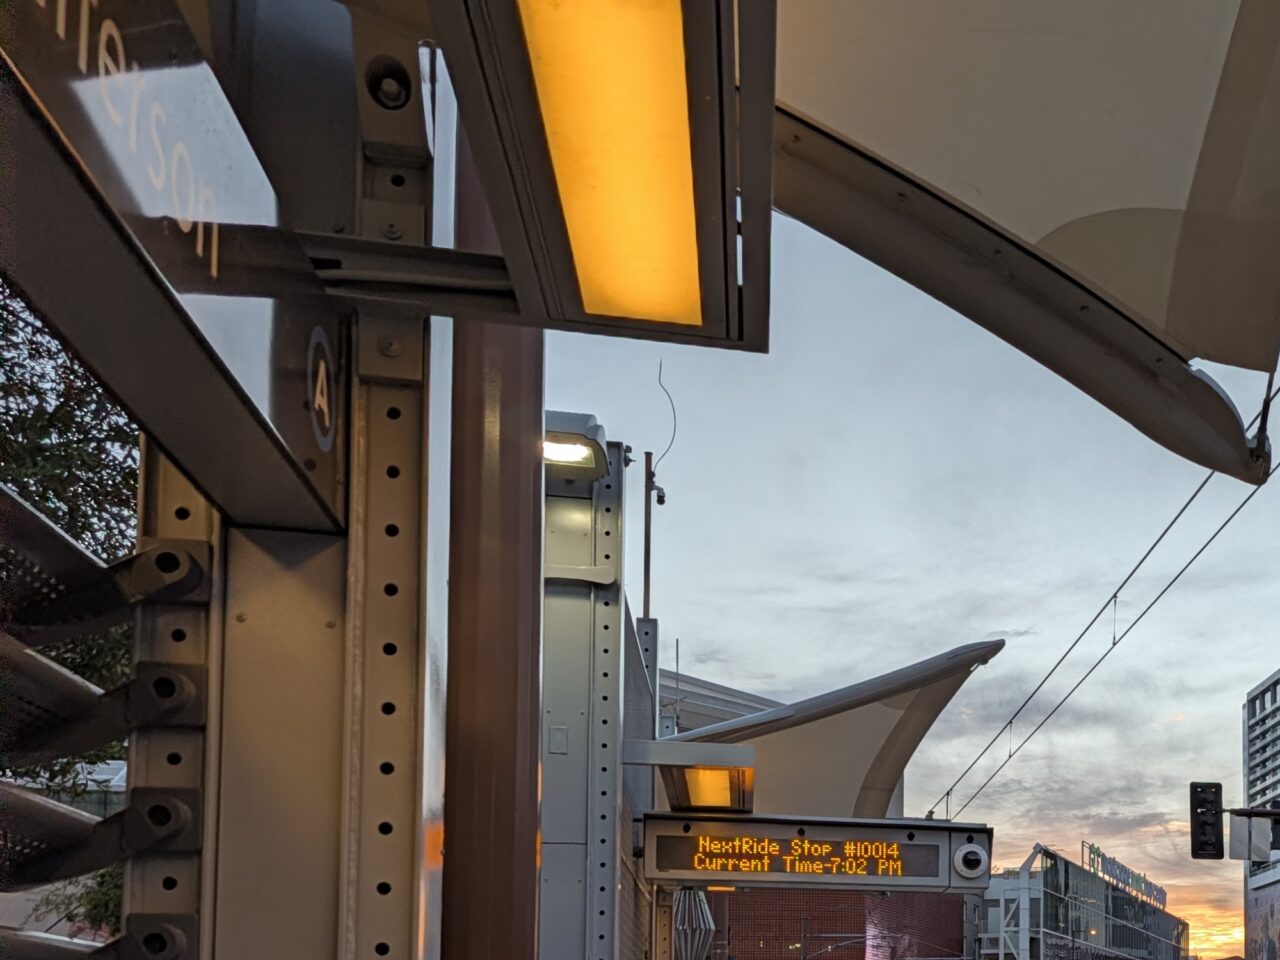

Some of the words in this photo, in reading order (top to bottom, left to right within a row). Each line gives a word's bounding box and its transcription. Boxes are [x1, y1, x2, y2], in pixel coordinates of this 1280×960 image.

[314, 359, 330, 428] A
[699, 836, 780, 855] NextRide
[791, 839, 832, 856] Stop
[844, 841, 899, 858] #10014
[694, 854, 770, 872] Current
[782, 855, 867, 875] Time-7:02
[877, 859, 902, 875] PM
